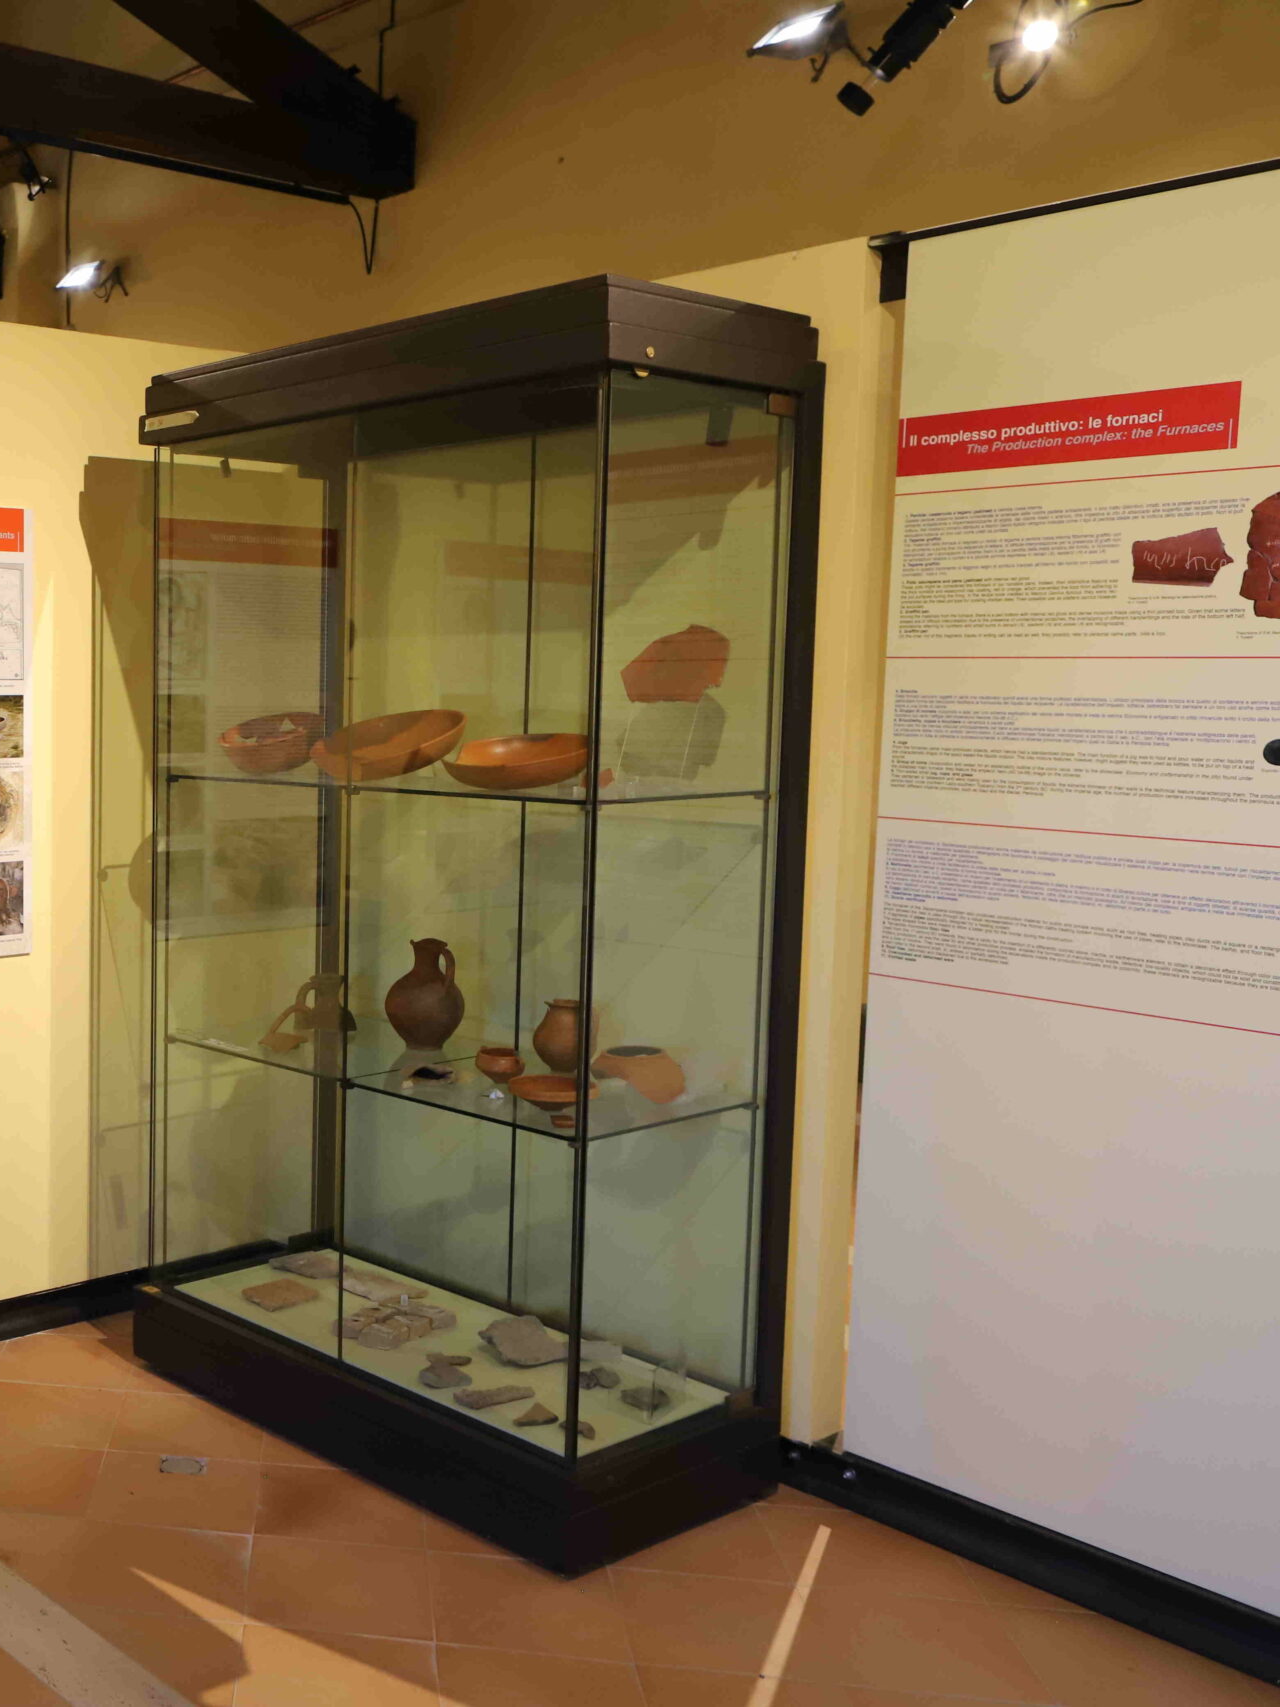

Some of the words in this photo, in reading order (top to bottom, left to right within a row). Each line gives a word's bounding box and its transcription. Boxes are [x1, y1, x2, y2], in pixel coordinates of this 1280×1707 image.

[909, 434, 918, 447] Il
[921, 429, 997, 445] complesso
[1001, 419, 1084, 441] produttivo:
[1088, 416, 1102, 429] le
[1106, 409, 1163, 428] fornaci
[967, 443, 989, 454] The
[992, 436, 1062, 453] Production
[1065, 430, 1128, 446] complex:
[1131, 427, 1153, 439] the
[1157, 421, 1225, 437] Furnaces
